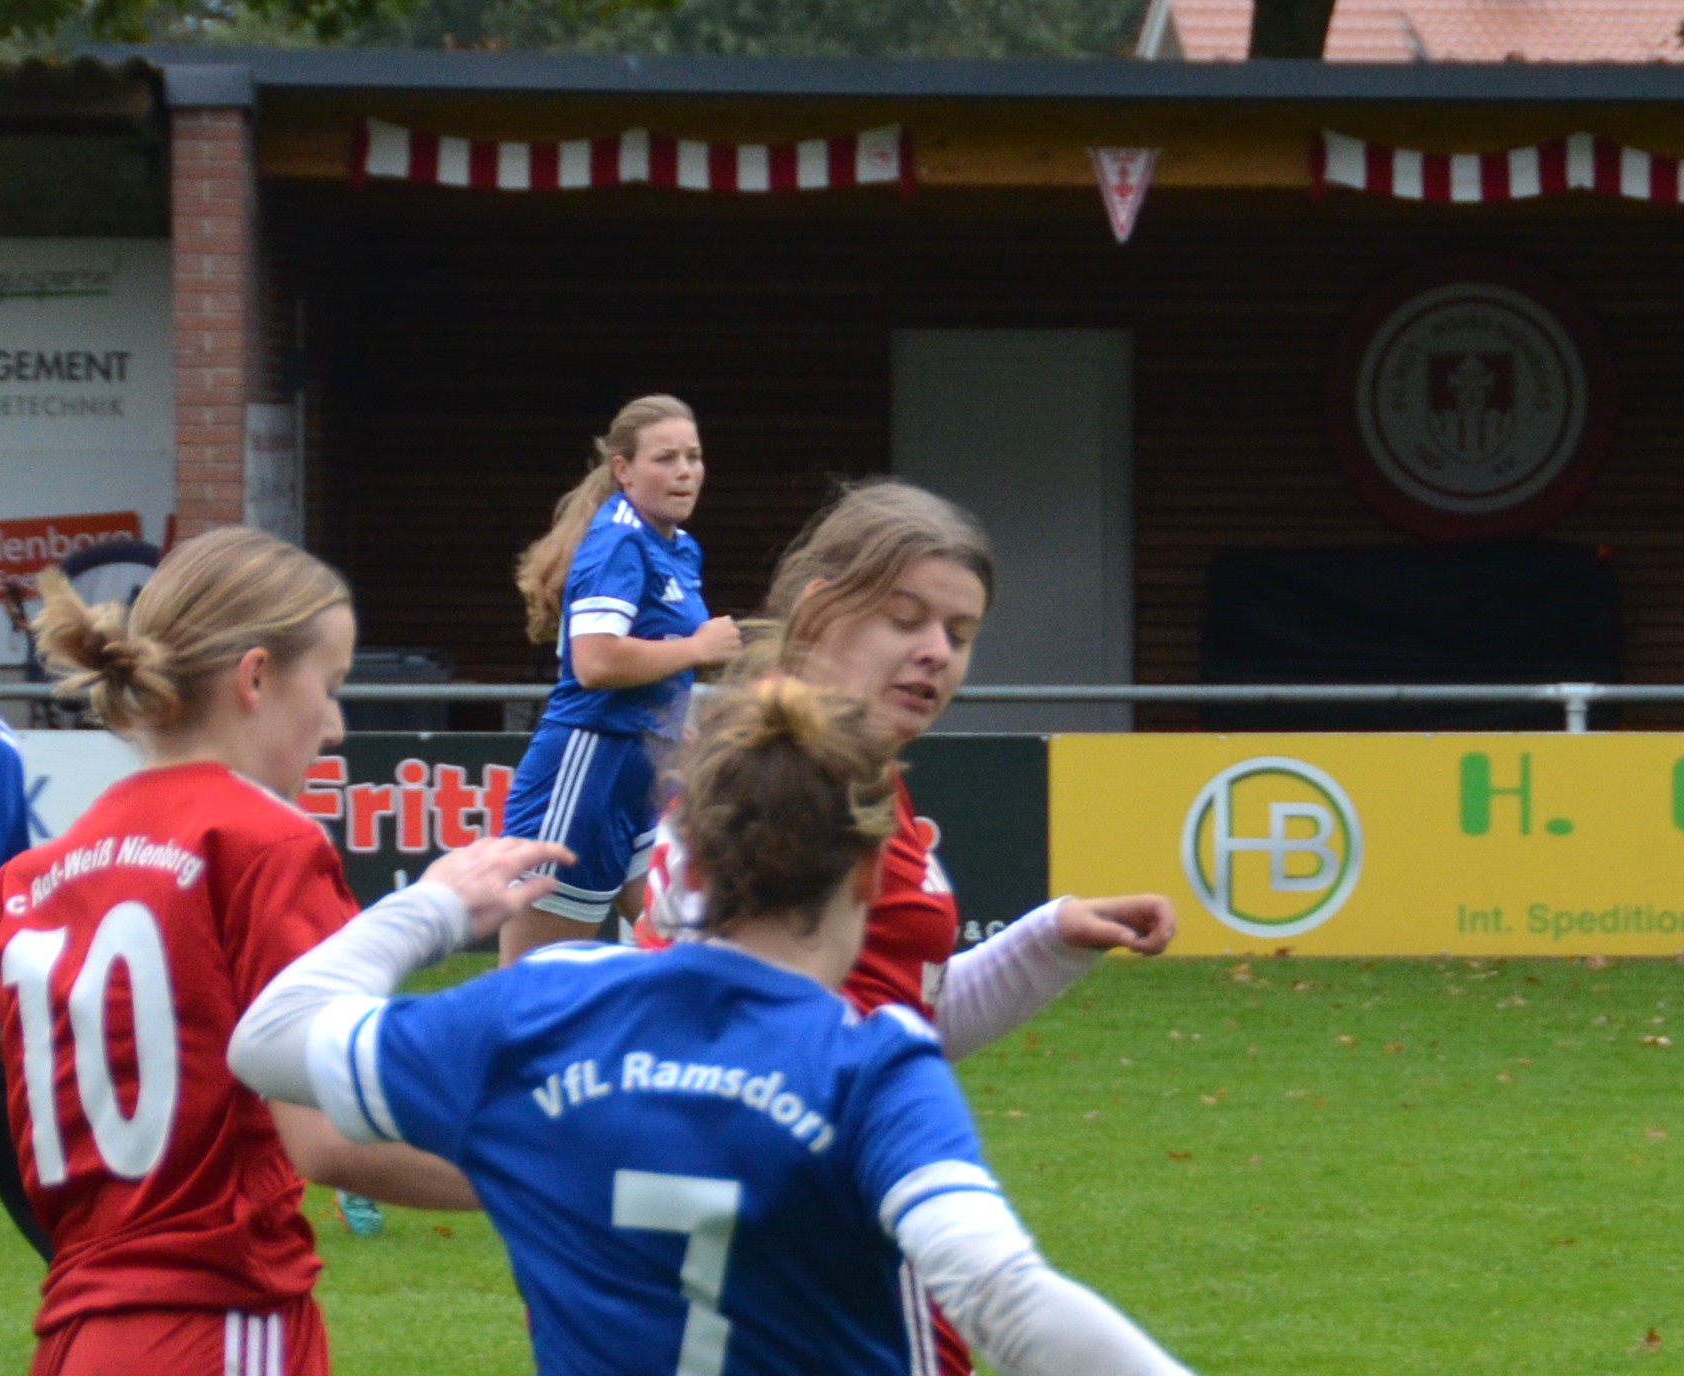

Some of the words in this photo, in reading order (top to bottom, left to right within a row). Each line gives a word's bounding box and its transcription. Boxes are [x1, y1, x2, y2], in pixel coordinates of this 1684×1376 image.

[1459, 751, 1574, 836] H.
[30, 837, 115, 908] Rot-Weiß
[116, 836, 206, 890] Nienborg
[1458, 903, 1514, 934] Int.
[2, 899, 181, 1188] 10
[532, 1060, 612, 1119] VfL
